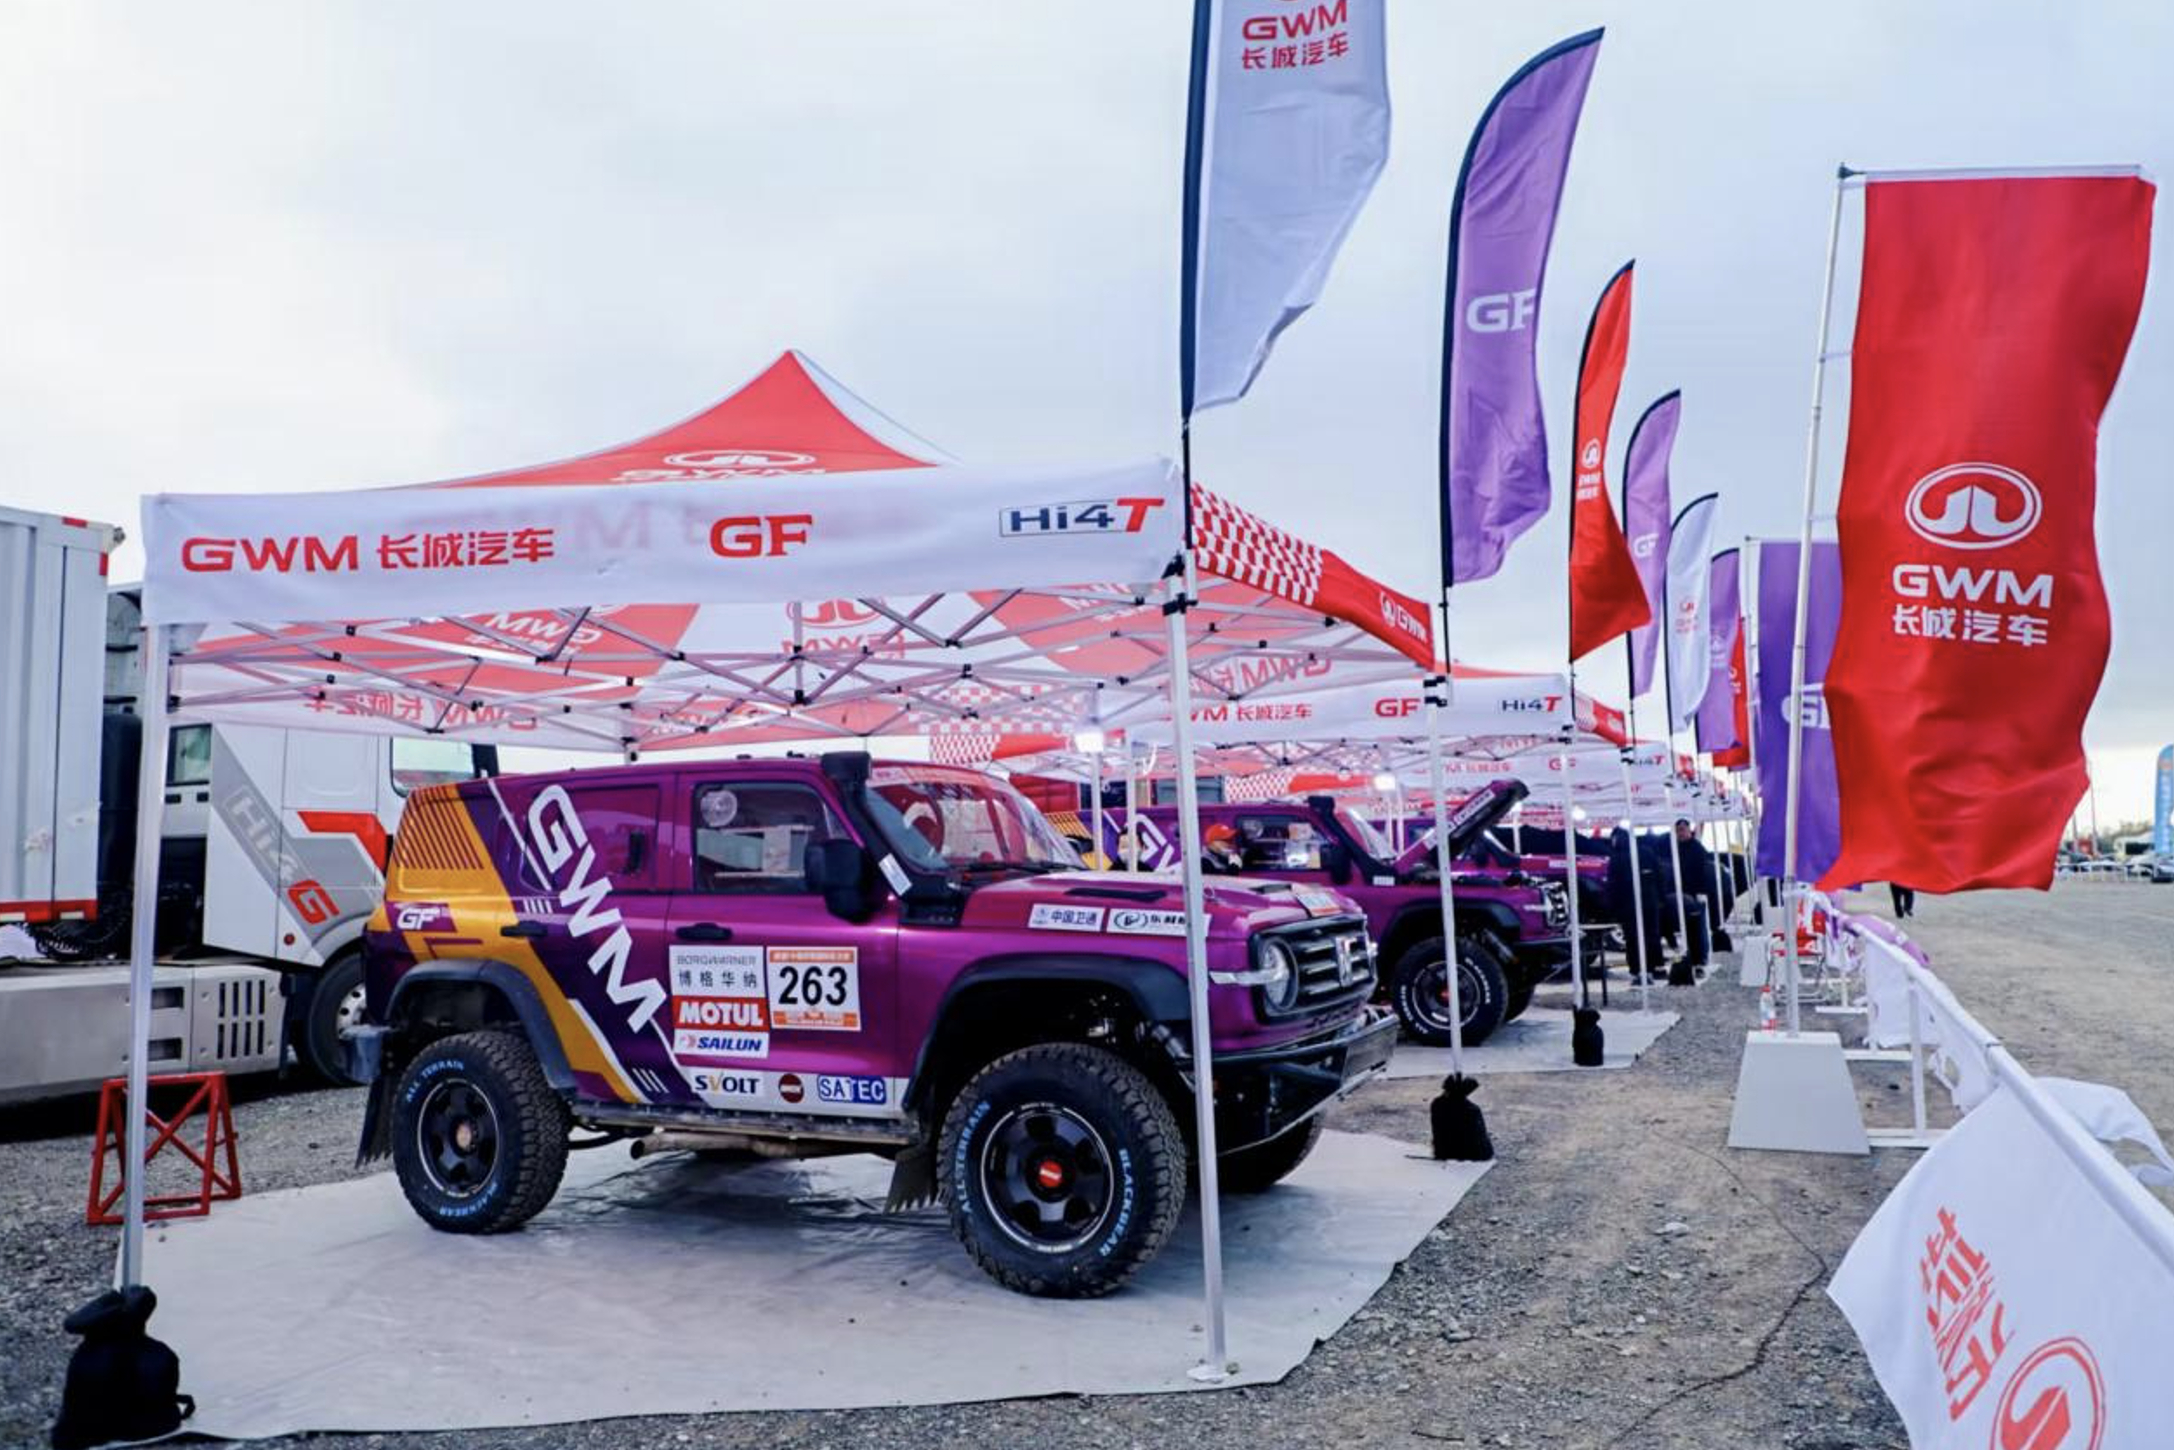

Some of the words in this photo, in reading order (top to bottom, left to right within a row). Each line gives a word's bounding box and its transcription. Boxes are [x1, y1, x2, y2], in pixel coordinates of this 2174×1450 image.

[1242, 0, 1348, 41] GWM
[1241, 32, 1350, 70] 长城汽车
[1009, 497, 1166, 534] Hi4T
[182, 535, 360, 573] GWM
[376, 528, 555, 571] 长城汽车
[710, 514, 814, 558] GF
[1892, 563, 2054, 609] GWM
[1892, 603, 2050, 648] 长城汽车
[1236, 703, 1313, 722] 长城汽车
[1375, 697, 1421, 718] GF
[1502, 695, 1563, 713] Hi4T
[397, 907, 441, 930] GF
[527, 784, 667, 1033] GWM
[1050, 909, 1098, 926] 中国卫通
[778, 966, 848, 1007] 263
[678, 1001, 765, 1027] MOTUL
[697, 1036, 762, 1051] SAILUN
[694, 1073, 761, 1095] SVOLT
[819, 1077, 885, 1101] SATEC
